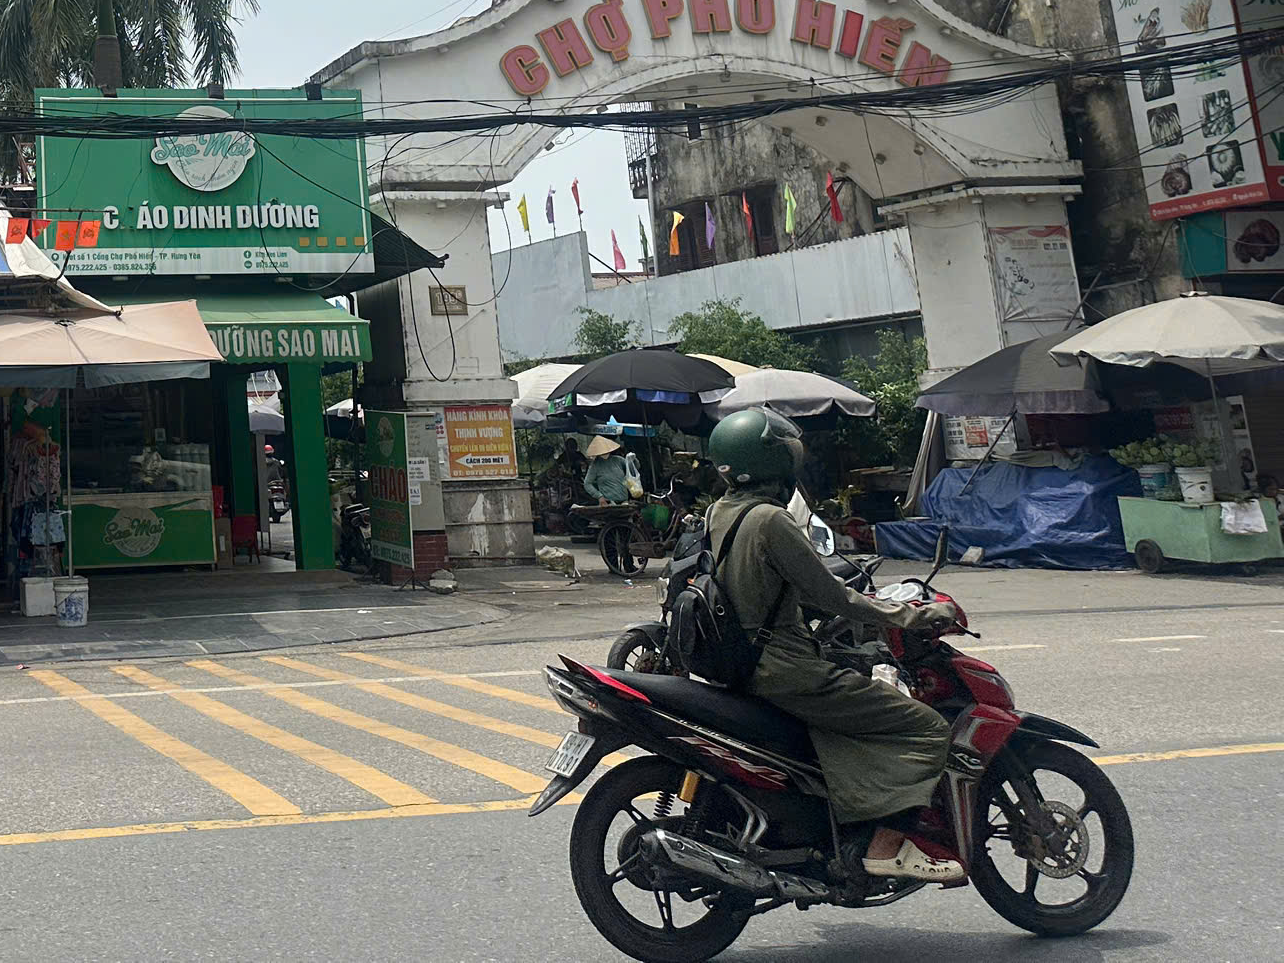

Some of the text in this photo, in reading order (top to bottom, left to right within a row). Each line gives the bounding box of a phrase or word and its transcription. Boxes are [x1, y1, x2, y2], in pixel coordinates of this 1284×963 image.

[154, 135, 200, 161] Sao
[173, 204, 232, 230] DINH
[277, 327, 316, 358] SAO
